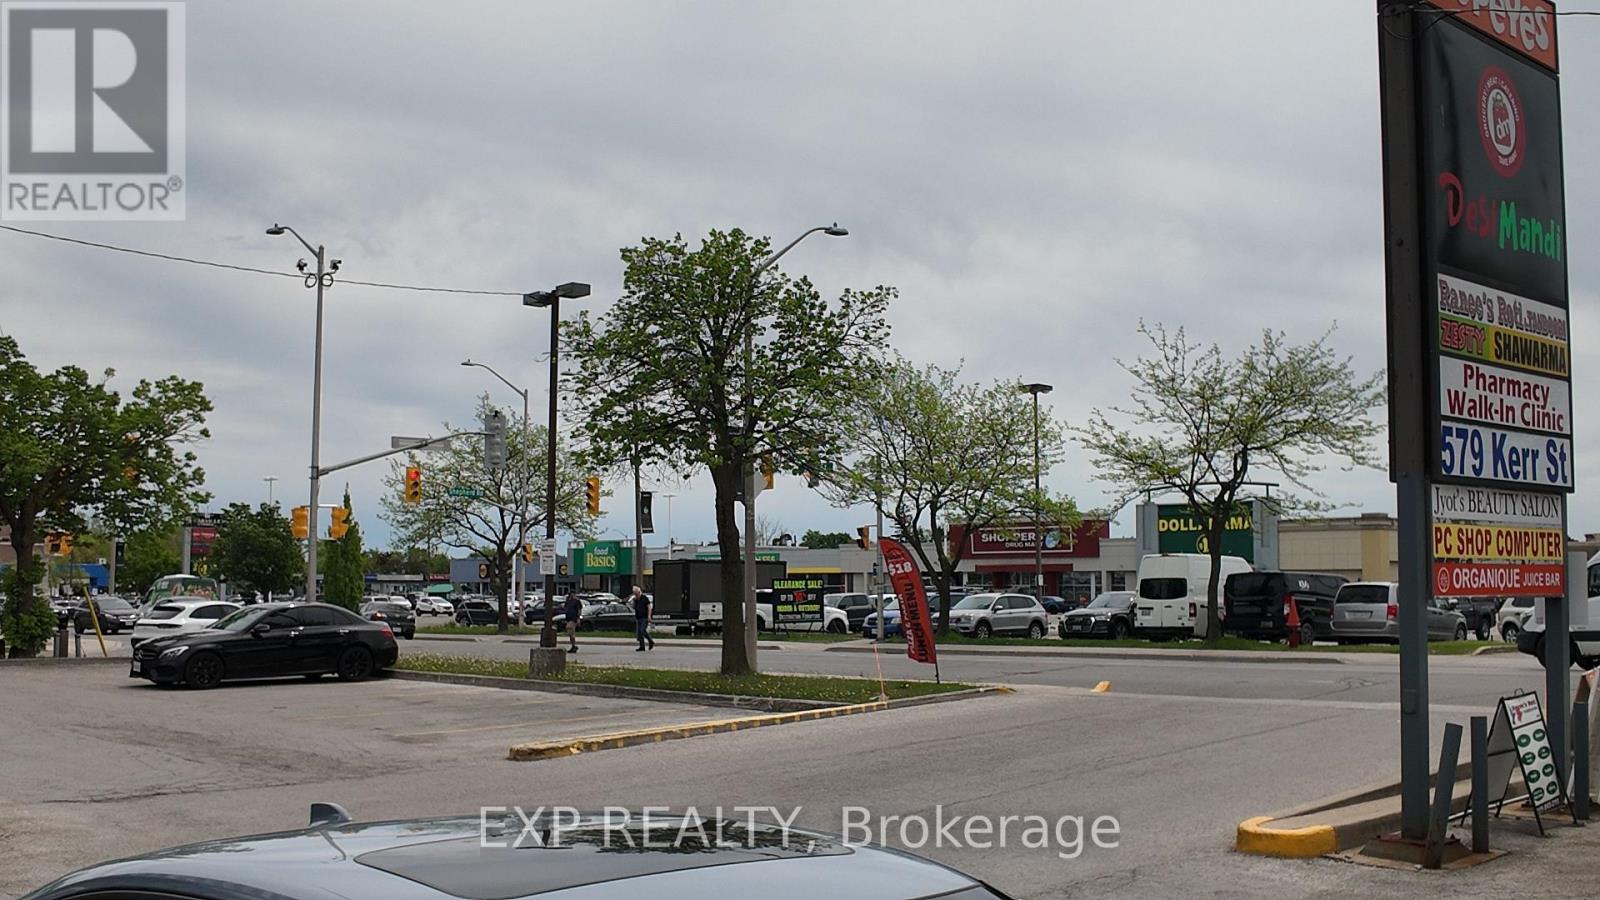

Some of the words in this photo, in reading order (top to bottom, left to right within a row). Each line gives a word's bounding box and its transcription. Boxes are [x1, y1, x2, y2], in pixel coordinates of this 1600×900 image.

[1499, 200, 1561, 261] Mandi
[1439, 279, 1495, 323] Ranee's
[1497, 296, 1523, 331] Roti
[1441, 320, 1485, 355] ZESTY
[1494, 331, 1567, 375] SHAWARMA
[1463, 363, 1550, 411] Pharmacy
[1447, 388, 1516, 425] Walk-In
[1520, 402, 1564, 432] Clinic
[1441, 425, 1484, 477] 579
[1491, 432, 1539, 481] Kerr
[1546, 439, 1568, 484] St
[1434, 486, 1465, 516] Jyot's
[1467, 489, 1519, 516] BEAUTY
[1521, 494, 1560, 518] SALON
[587, 553, 616, 567] Basics
[1434, 526, 1453, 555] PC
[1457, 527, 1492, 556] SHOP
[1496, 529, 1562, 558] COMPUTER
[774, 580, 806, 589] CLEARANCE
[889, 562, 912, 576] $18
[1453, 567, 1521, 591] ORGANIQUE
[1522, 572, 1544, 587] JUICE
[1545, 573, 1561, 587] BAR
[904, 582, 921, 620] MENU
